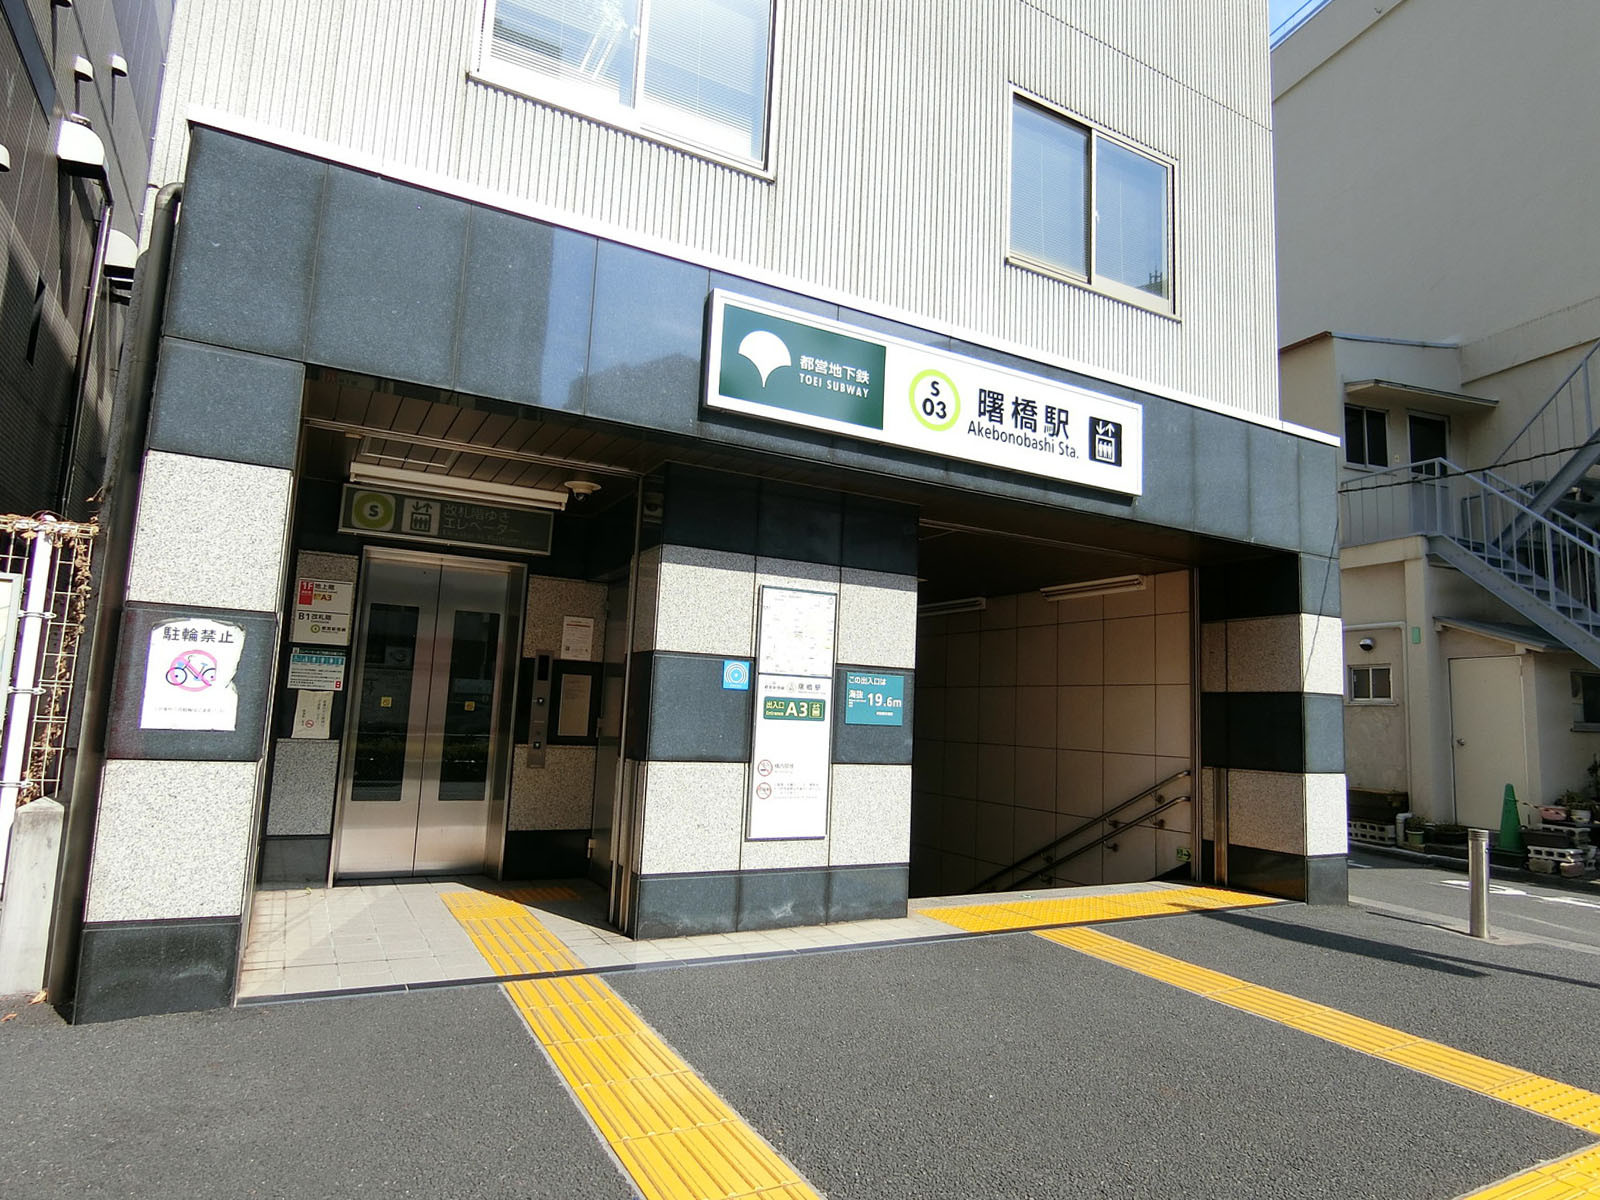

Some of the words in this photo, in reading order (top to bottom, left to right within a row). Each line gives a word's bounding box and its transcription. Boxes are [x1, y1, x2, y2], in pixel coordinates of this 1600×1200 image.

[800, 355, 870, 384] 都営地下鉄
[799, 373, 822, 388] TOEI
[826, 380, 869, 398] SUBWAY
[930, 380, 940, 397] S
[922, 397, 947, 419] 03
[978, 388, 1069, 439] 曙橋駅
[967, 420, 1055, 454] Akebonobashi
[1058, 441, 1079, 459] Sta.
[368, 505, 379, 518] S
[298, 612, 310, 620] B1
[163, 626, 234, 644] 駐輪禁止
[848, 675, 887, 686] この出入口は
[766, 700, 785, 709] 出入口
[867, 692, 902, 708] 19.6m
[785, 701, 808, 717] A3
